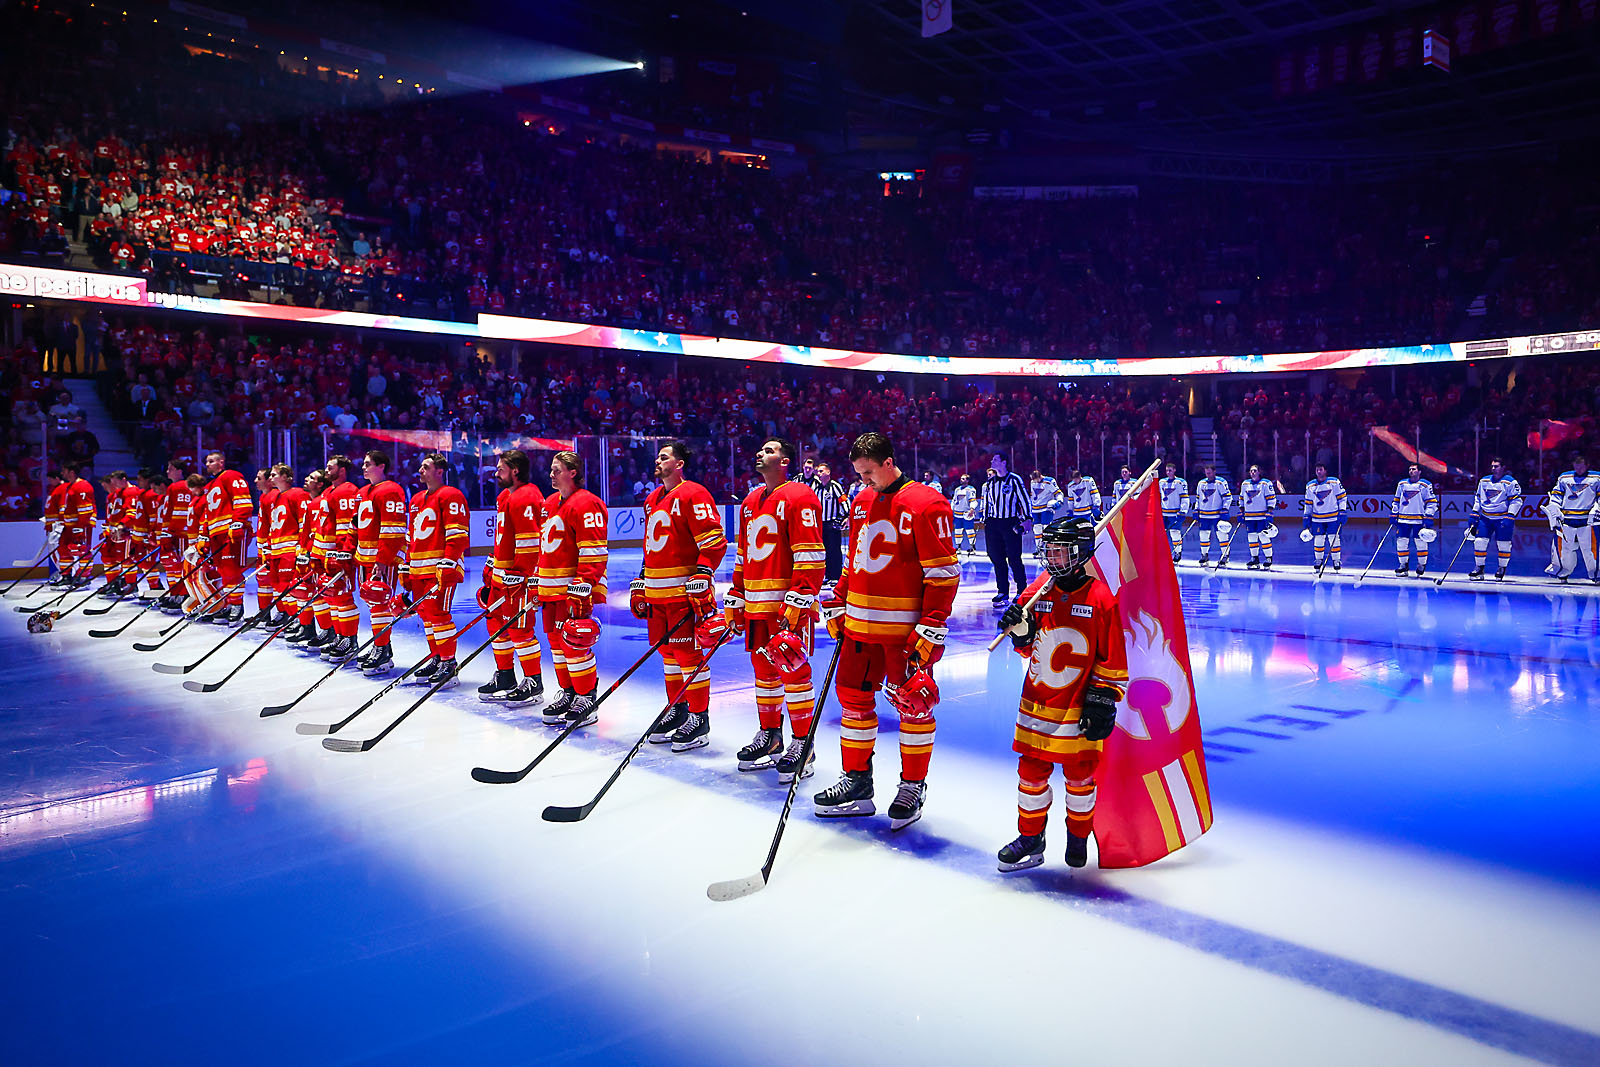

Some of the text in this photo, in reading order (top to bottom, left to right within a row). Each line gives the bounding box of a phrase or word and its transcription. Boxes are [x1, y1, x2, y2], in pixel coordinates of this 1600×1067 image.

[35, 276, 141, 302] perilous
[231, 479, 248, 489] 43
[177, 493, 191, 502] 29
[385, 500, 405, 514] 92
[449, 502, 466, 517] 94
[523, 505, 534, 520] 4
[670, 498, 681, 517] A
[776, 500, 786, 520] A
[583, 512, 604, 529] 20
[801, 508, 818, 528] 91
[899, 511, 912, 535] C
[936, 515, 952, 539] 11
[1072, 607, 1092, 615] TELUS
